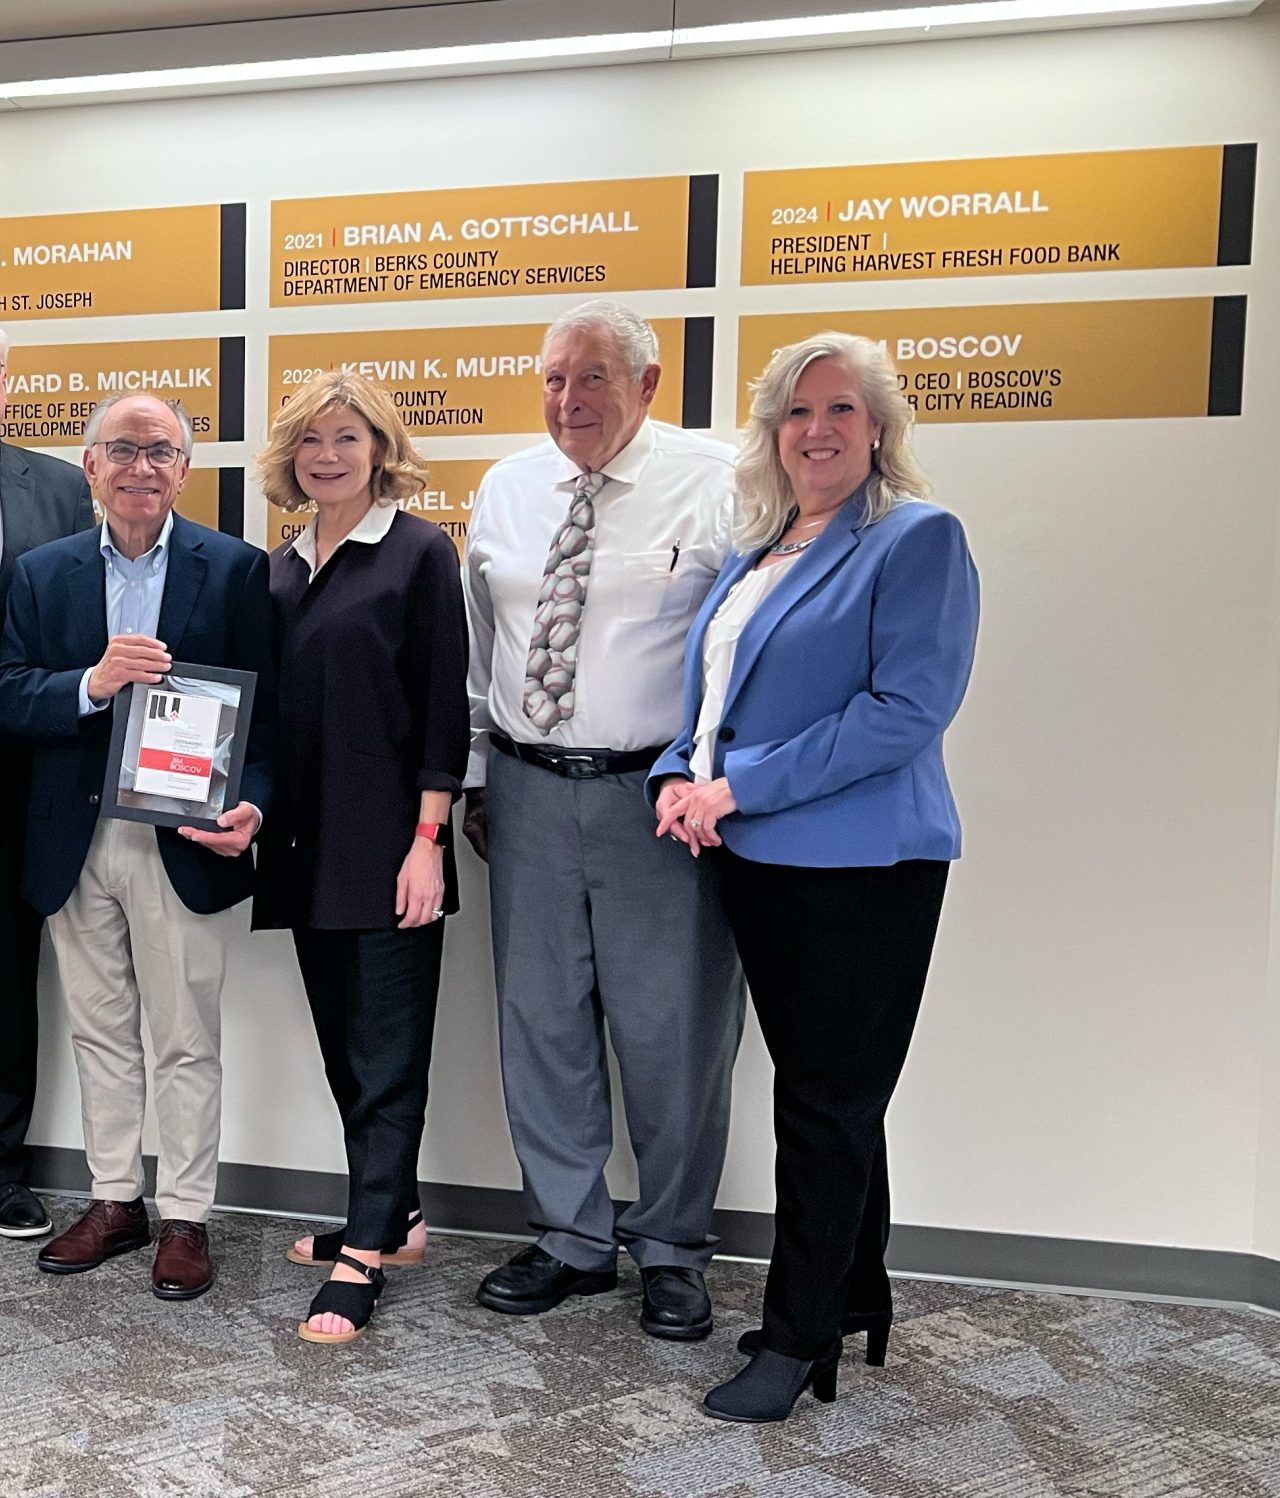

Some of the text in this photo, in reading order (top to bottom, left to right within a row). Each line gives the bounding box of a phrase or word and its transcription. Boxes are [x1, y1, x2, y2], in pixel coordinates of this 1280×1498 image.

[771, 189, 1049, 225] 2024 JAY WORRALL
[284, 210, 639, 250] 2021 BRIAN A. GOTTSCHALL
[13, 240, 133, 266] MORAHAN
[771, 233, 872, 255] PRESIDENT
[284, 250, 499, 278] DIRECTOR BERKS COUNTY
[770, 243, 1121, 276] HELPING HARVEST FRESH FOOD BANK
[284, 265, 606, 297] DEPARTMENT OF EMERGENCY SERVICES
[12, 295, 32, 311] ST.
[37, 292, 93, 310] JOSEPH
[897, 334, 1023, 360] BOSCOV
[69, 373, 90, 392] B.
[97, 367, 212, 391] MICHALIK
[341, 360, 416, 381] KEVIN
[423, 358, 448, 379] K.
[456, 355, 544, 378] MURP
[915, 372, 951, 390] CEO
[968, 369, 1062, 389] BOSCOV'S
[4, 403, 43, 419] FFICE
[47, 402, 66, 418] OF
[391, 390, 447, 408] OUNTY
[925, 393, 965, 411] CITY
[970, 390, 1052, 410] READING
[403, 408, 484, 426] UNDATION
